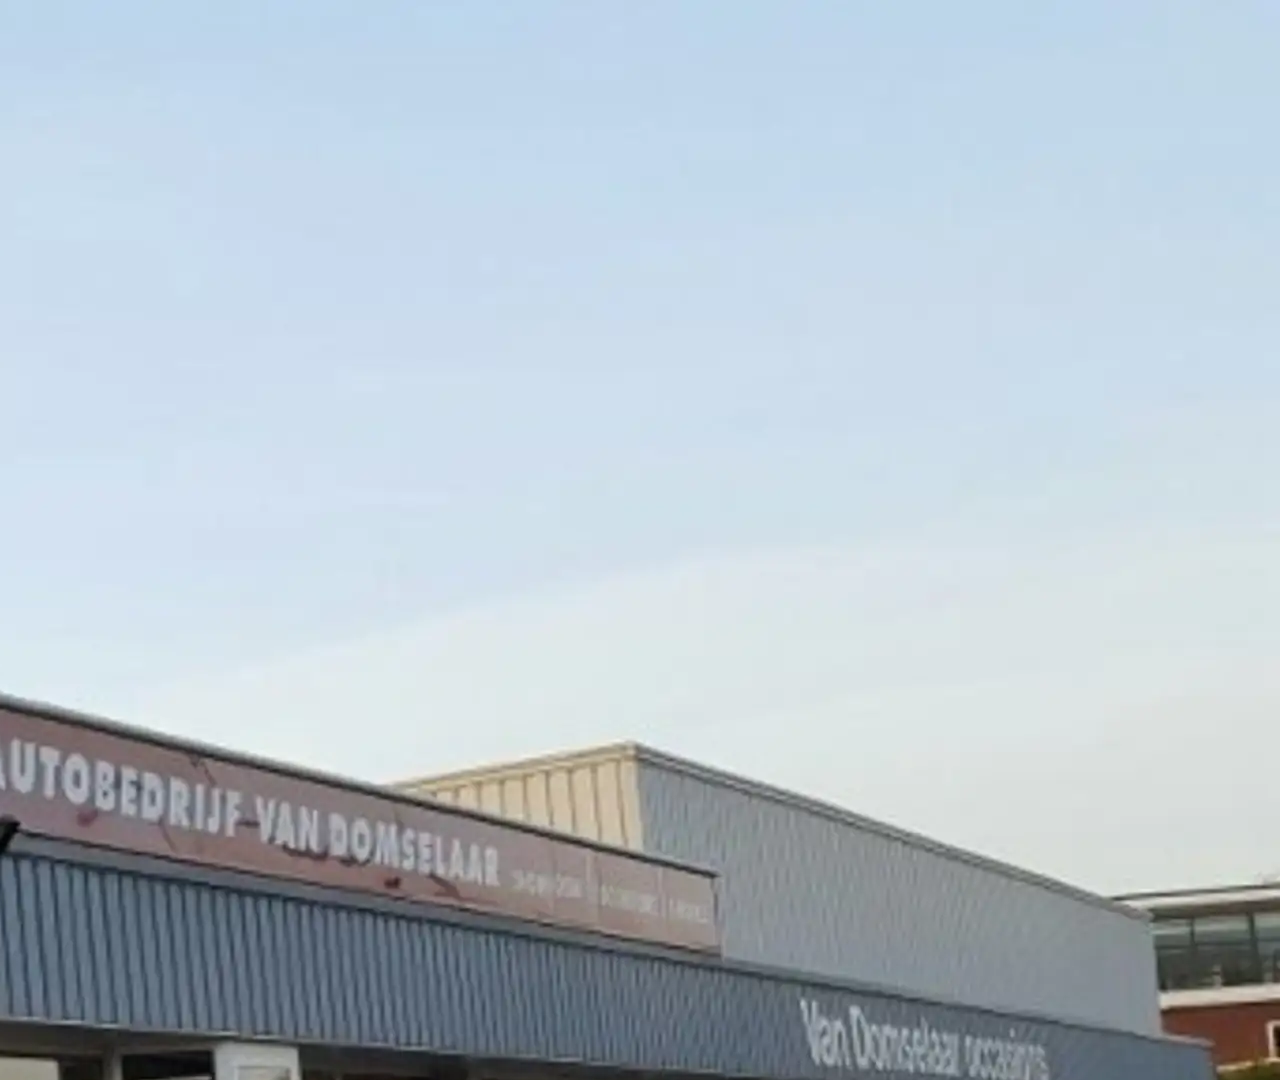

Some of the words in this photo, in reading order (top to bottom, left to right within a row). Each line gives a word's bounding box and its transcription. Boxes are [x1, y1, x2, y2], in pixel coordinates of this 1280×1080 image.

[256, 796, 320, 854] VAN
[328, 812, 501, 887] DOMSELAAR
[799, 998, 851, 1069] Van
[848, 1004, 961, 1077] Domselaar
